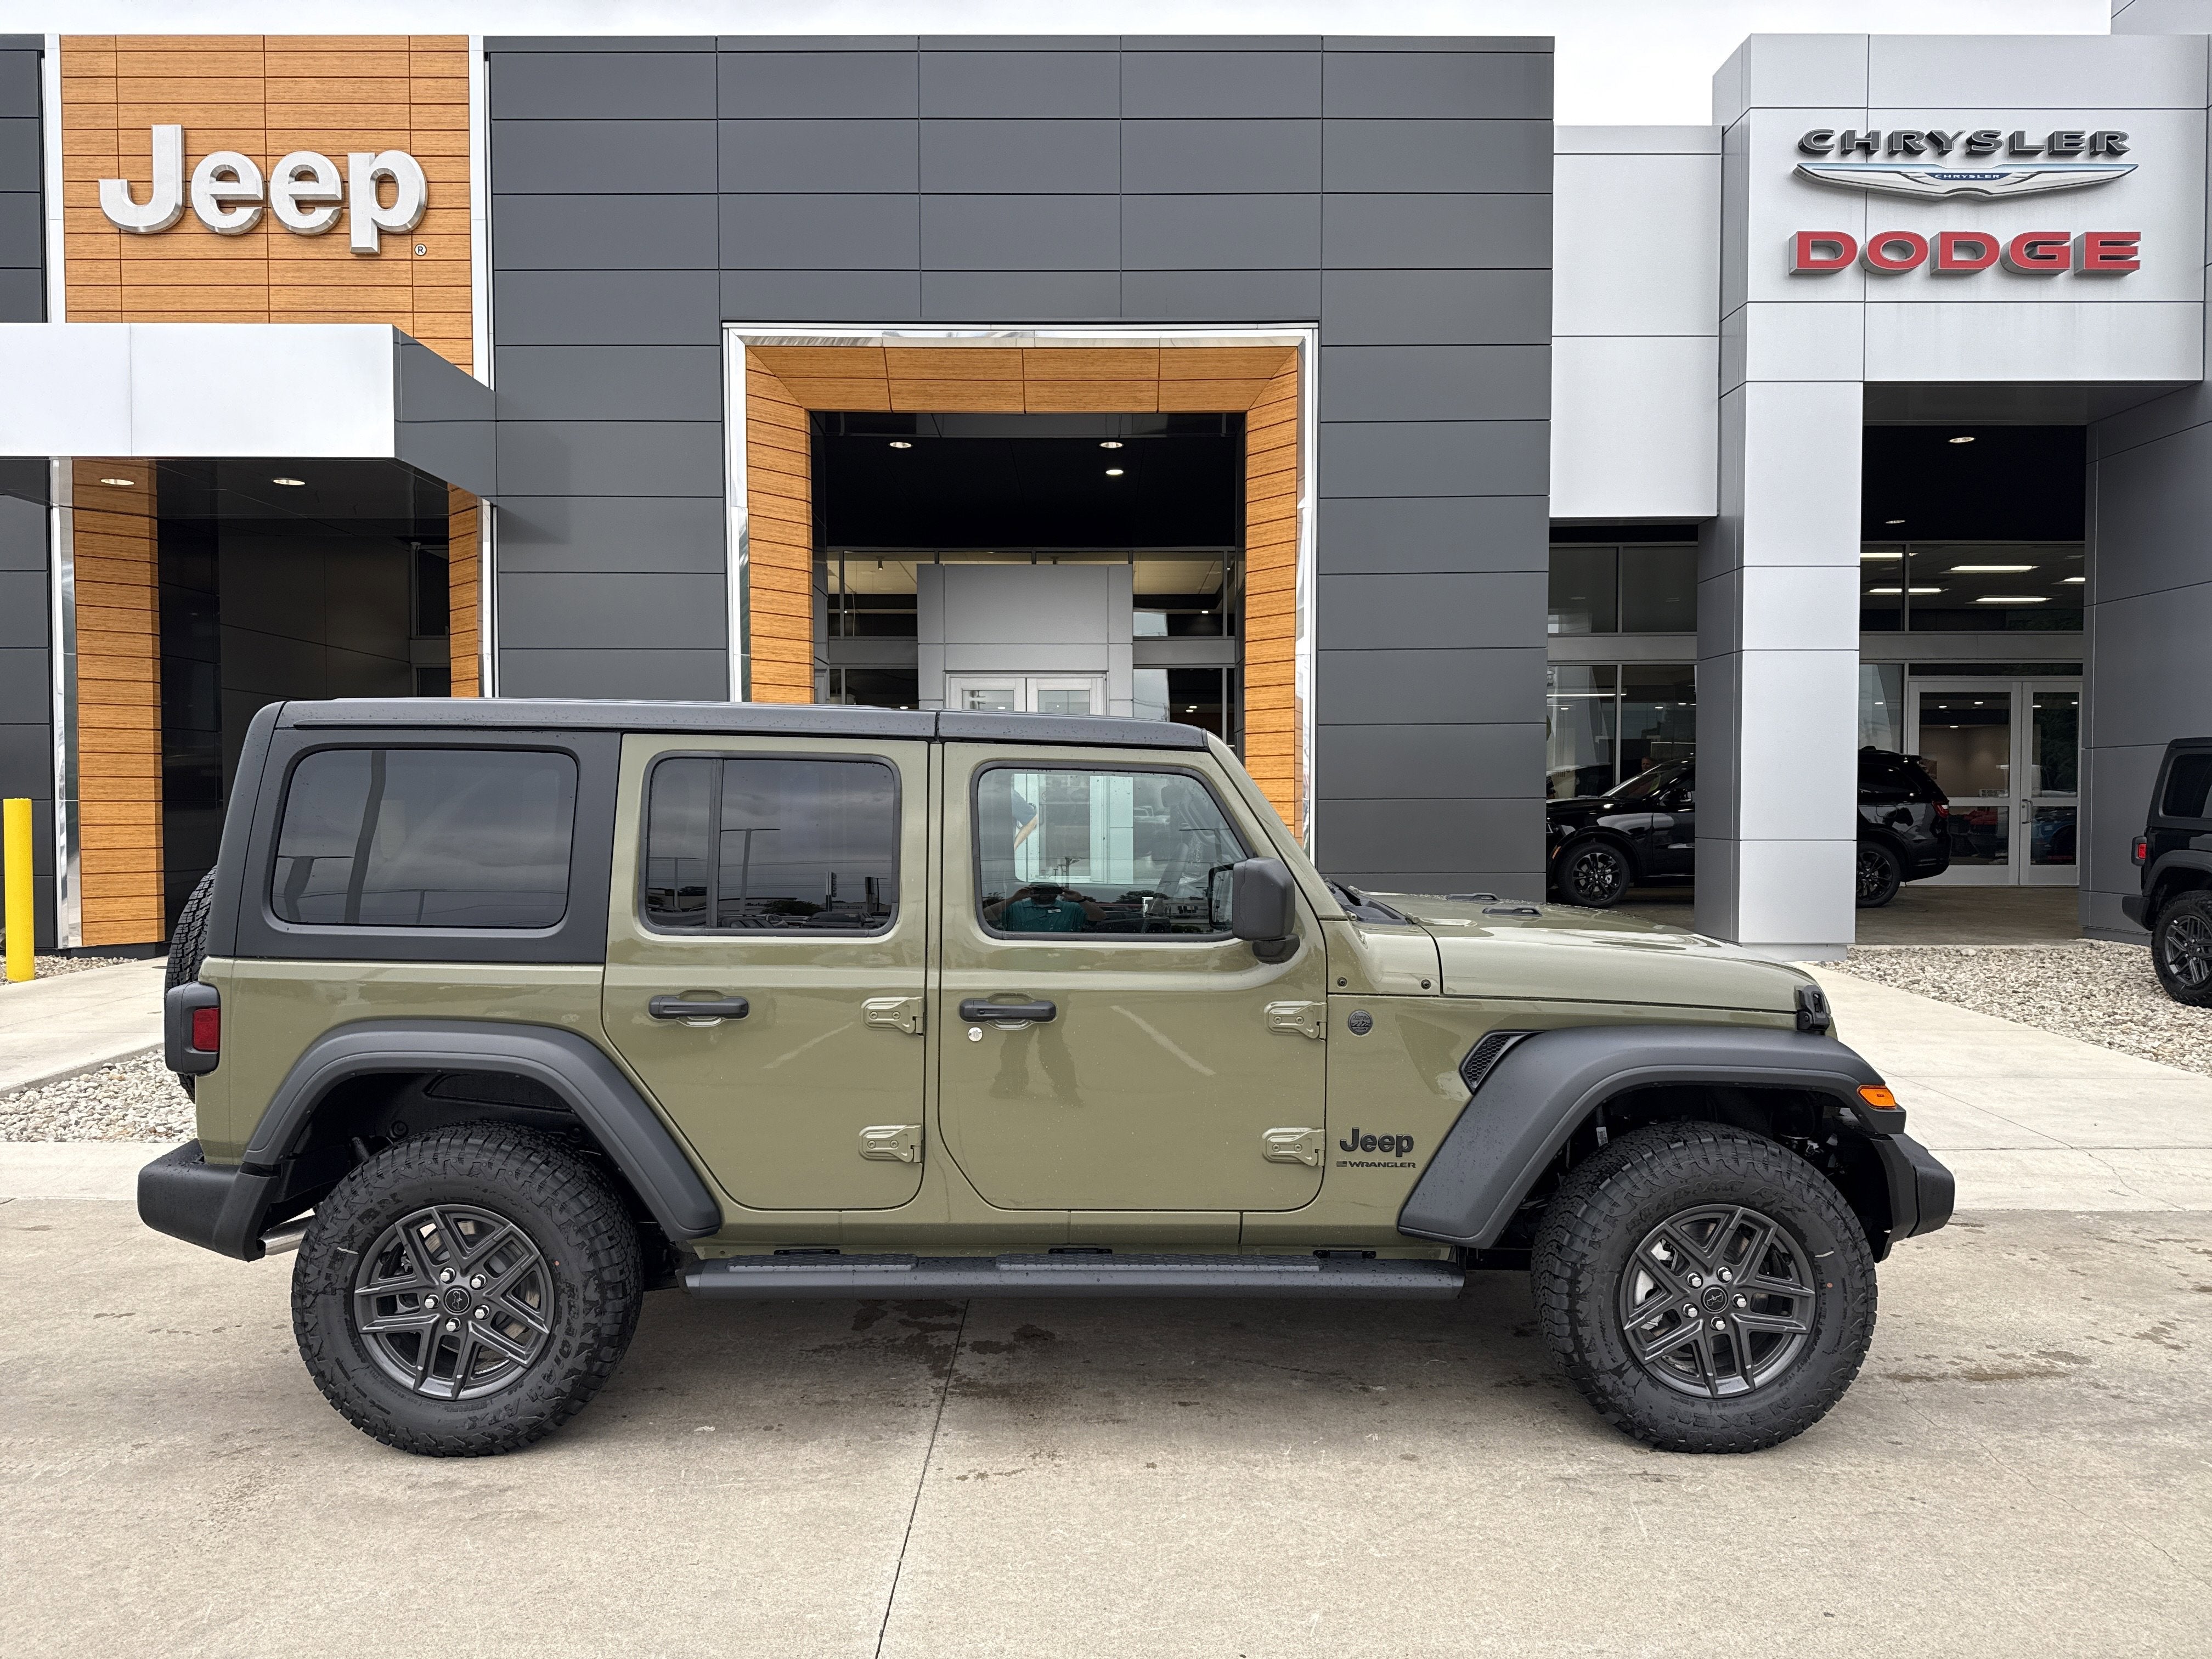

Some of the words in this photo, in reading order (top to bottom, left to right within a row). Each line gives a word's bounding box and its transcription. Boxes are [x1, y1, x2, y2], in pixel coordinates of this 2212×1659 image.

[1797, 129, 2130, 155] CHRYSLER
[98, 124, 428, 255] Jeep
[1788, 231, 2141, 275] DODGE
[1340, 1127, 1414, 1157] Jeep
